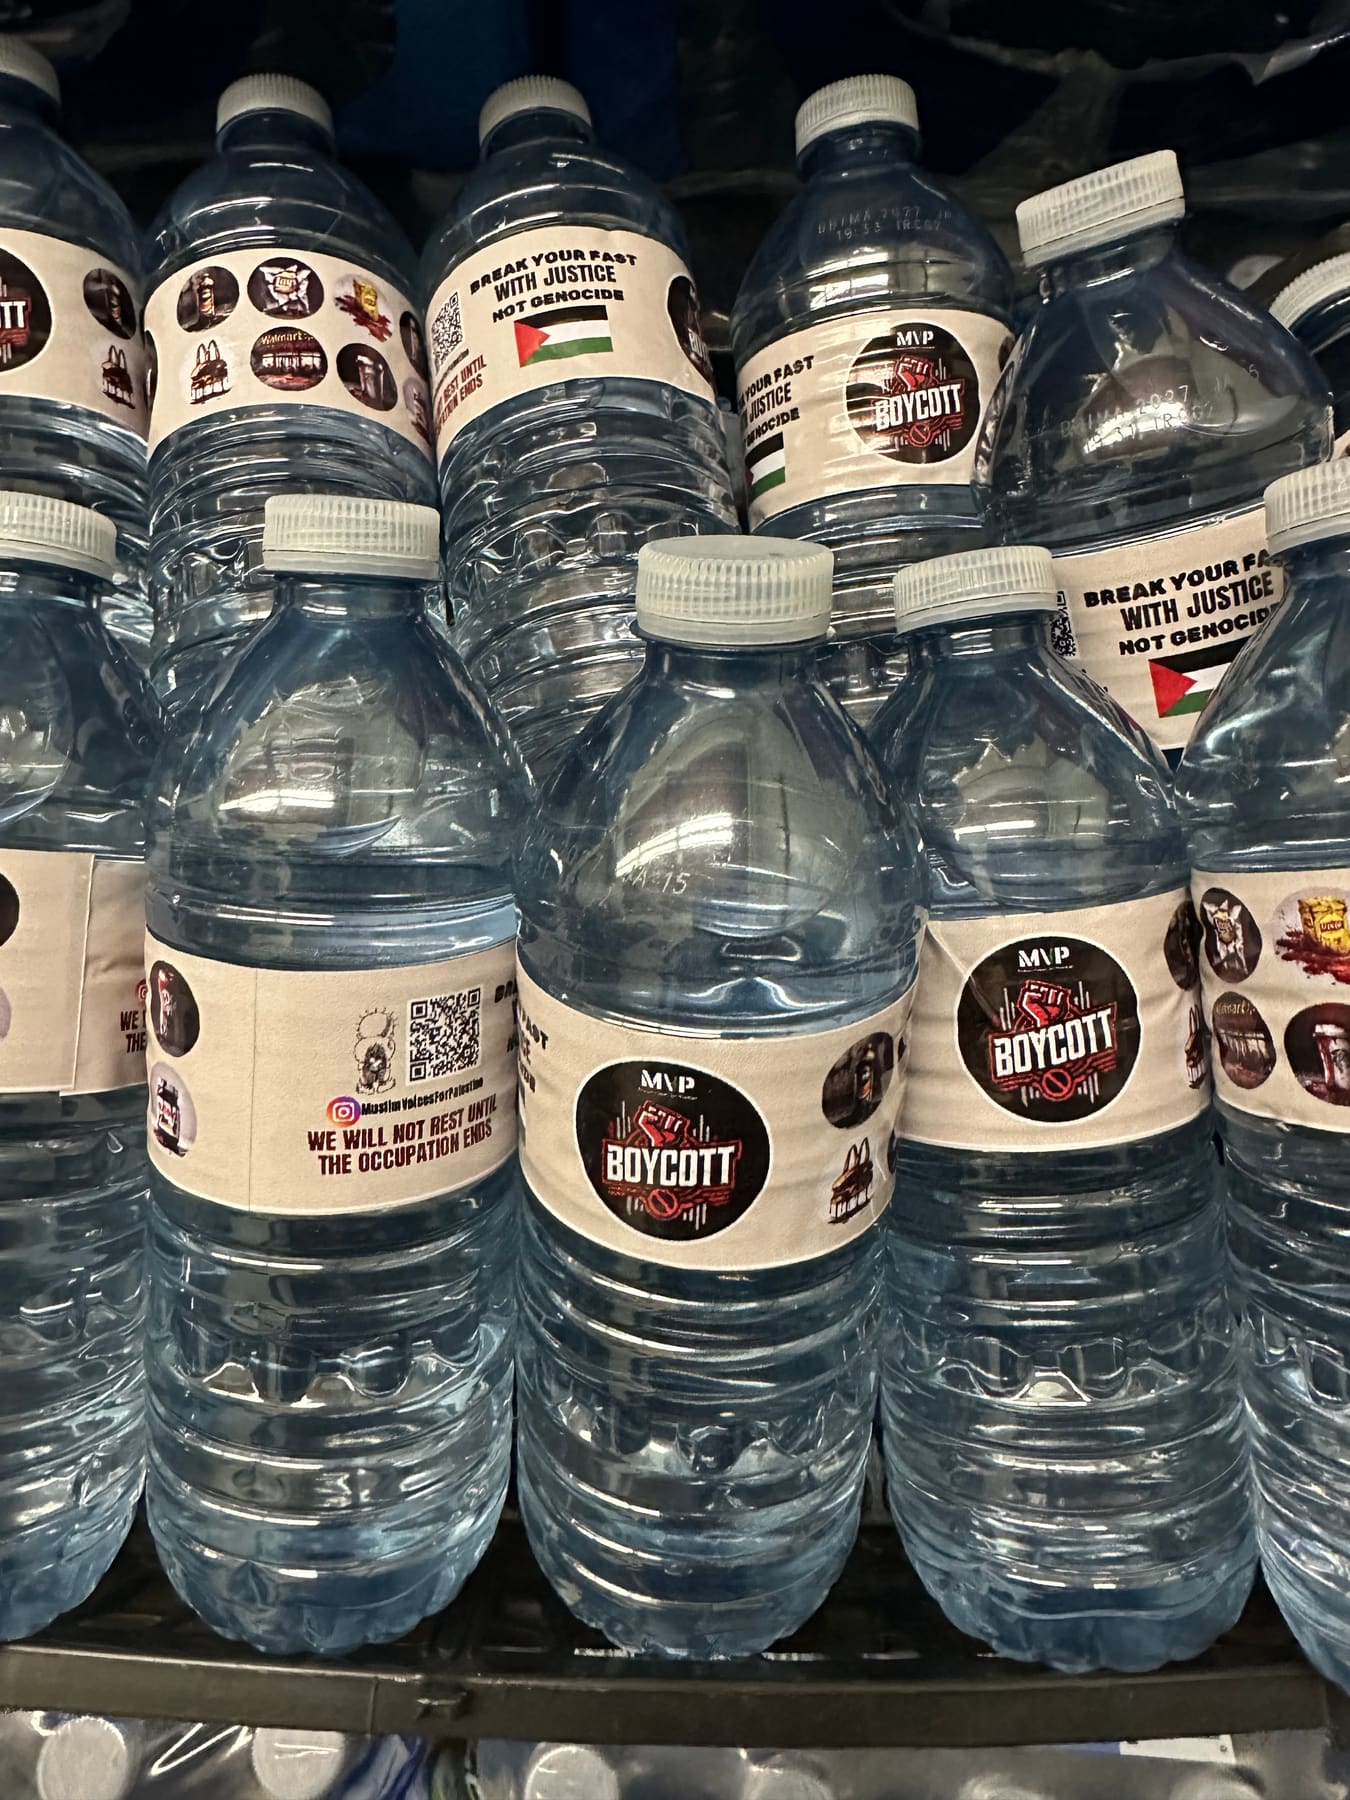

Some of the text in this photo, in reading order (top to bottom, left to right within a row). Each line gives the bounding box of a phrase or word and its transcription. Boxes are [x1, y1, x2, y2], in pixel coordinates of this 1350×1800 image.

[470, 249, 637, 294] BREAK YOUR FAST
[495, 265, 616, 303] WITH JUSTICE
[493, 289, 624, 323] NOT GENOCIDE
[896, 330, 934, 347] MVP
[745, 355, 815, 399] YOUR FAST
[749, 381, 792, 423] JUSTICE
[875, 383, 963, 432] BOYCOTT
[1084, 577, 1166, 608] BREAK
[1170, 560, 1239, 591] YOUR
[1120, 571, 1274, 631] WITH JUSTICE
[1119, 634, 1166, 656] NOT
[1018, 946, 1070, 967] MVP
[120, 1010, 139, 1032] WE
[995, 1008, 1112, 1077] BOYCOTT
[641, 1069, 695, 1093] MVP
[308, 1093, 497, 1152] WE WILL NOT REST UNTIL
[318, 1119, 493, 1176] THE OCCUPATION ENDS
[606, 1143, 735, 1186] BOYCOTT
